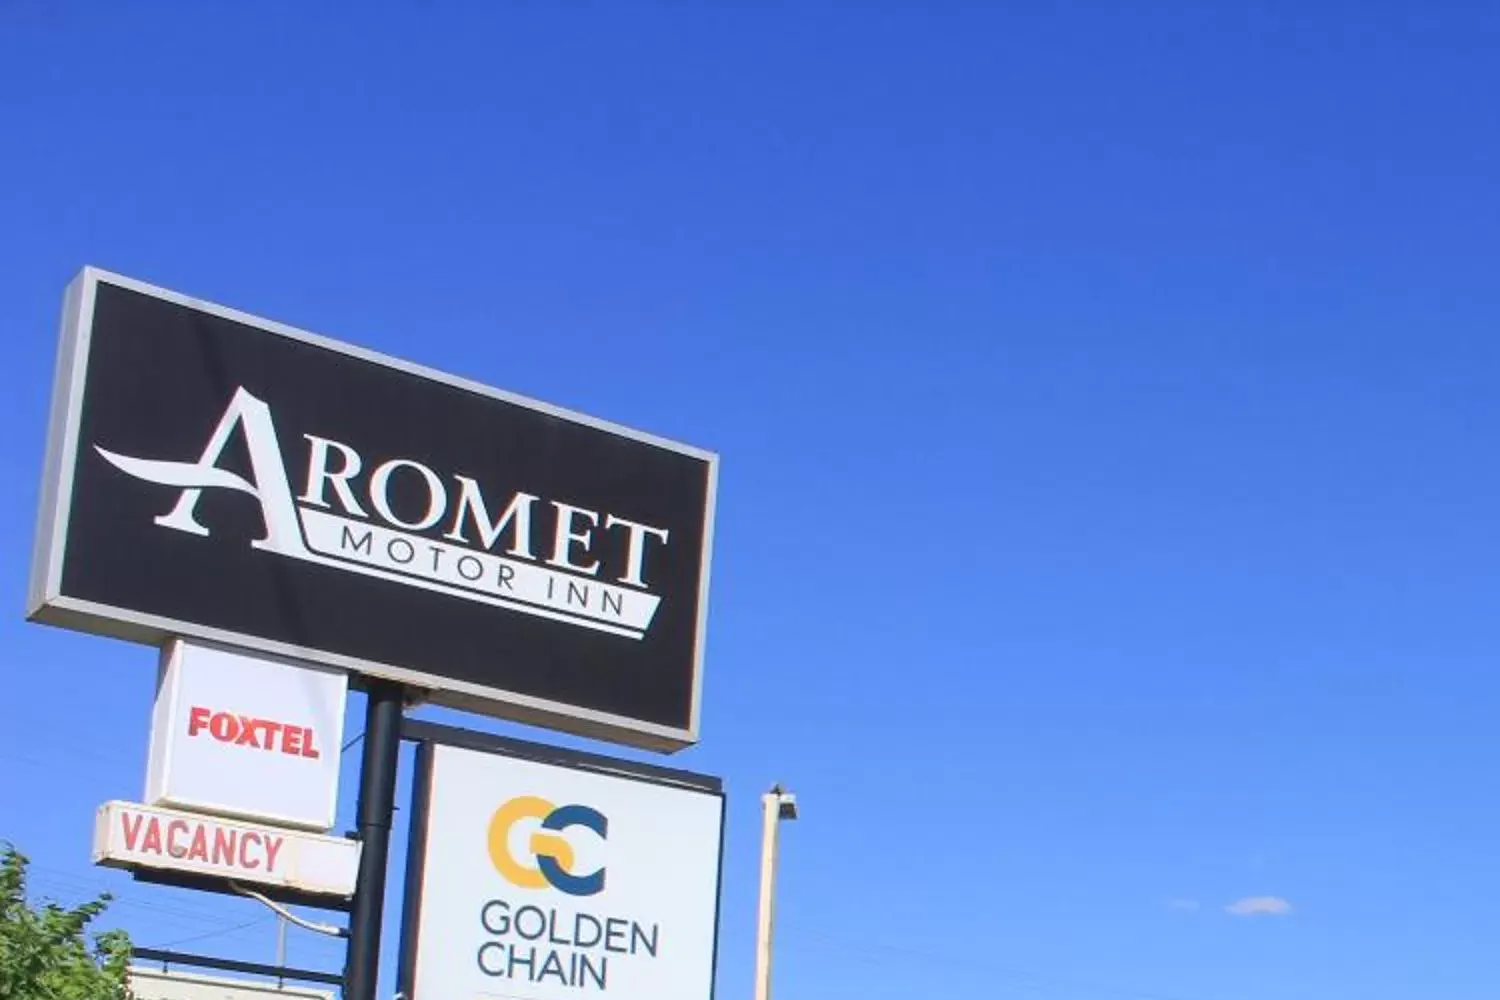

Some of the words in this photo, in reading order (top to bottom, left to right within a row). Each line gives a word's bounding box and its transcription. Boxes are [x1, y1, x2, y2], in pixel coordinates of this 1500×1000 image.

[94, 386, 669, 588] AROMET
[341, 525, 515, 590] MOTOR
[547, 576, 623, 616] INN
[188, 705, 320, 759] FOXTEL
[121, 812, 284, 873] VACANCY
[480, 899, 659, 957] GOLDEN
[476, 941, 607, 990] CHAIN
